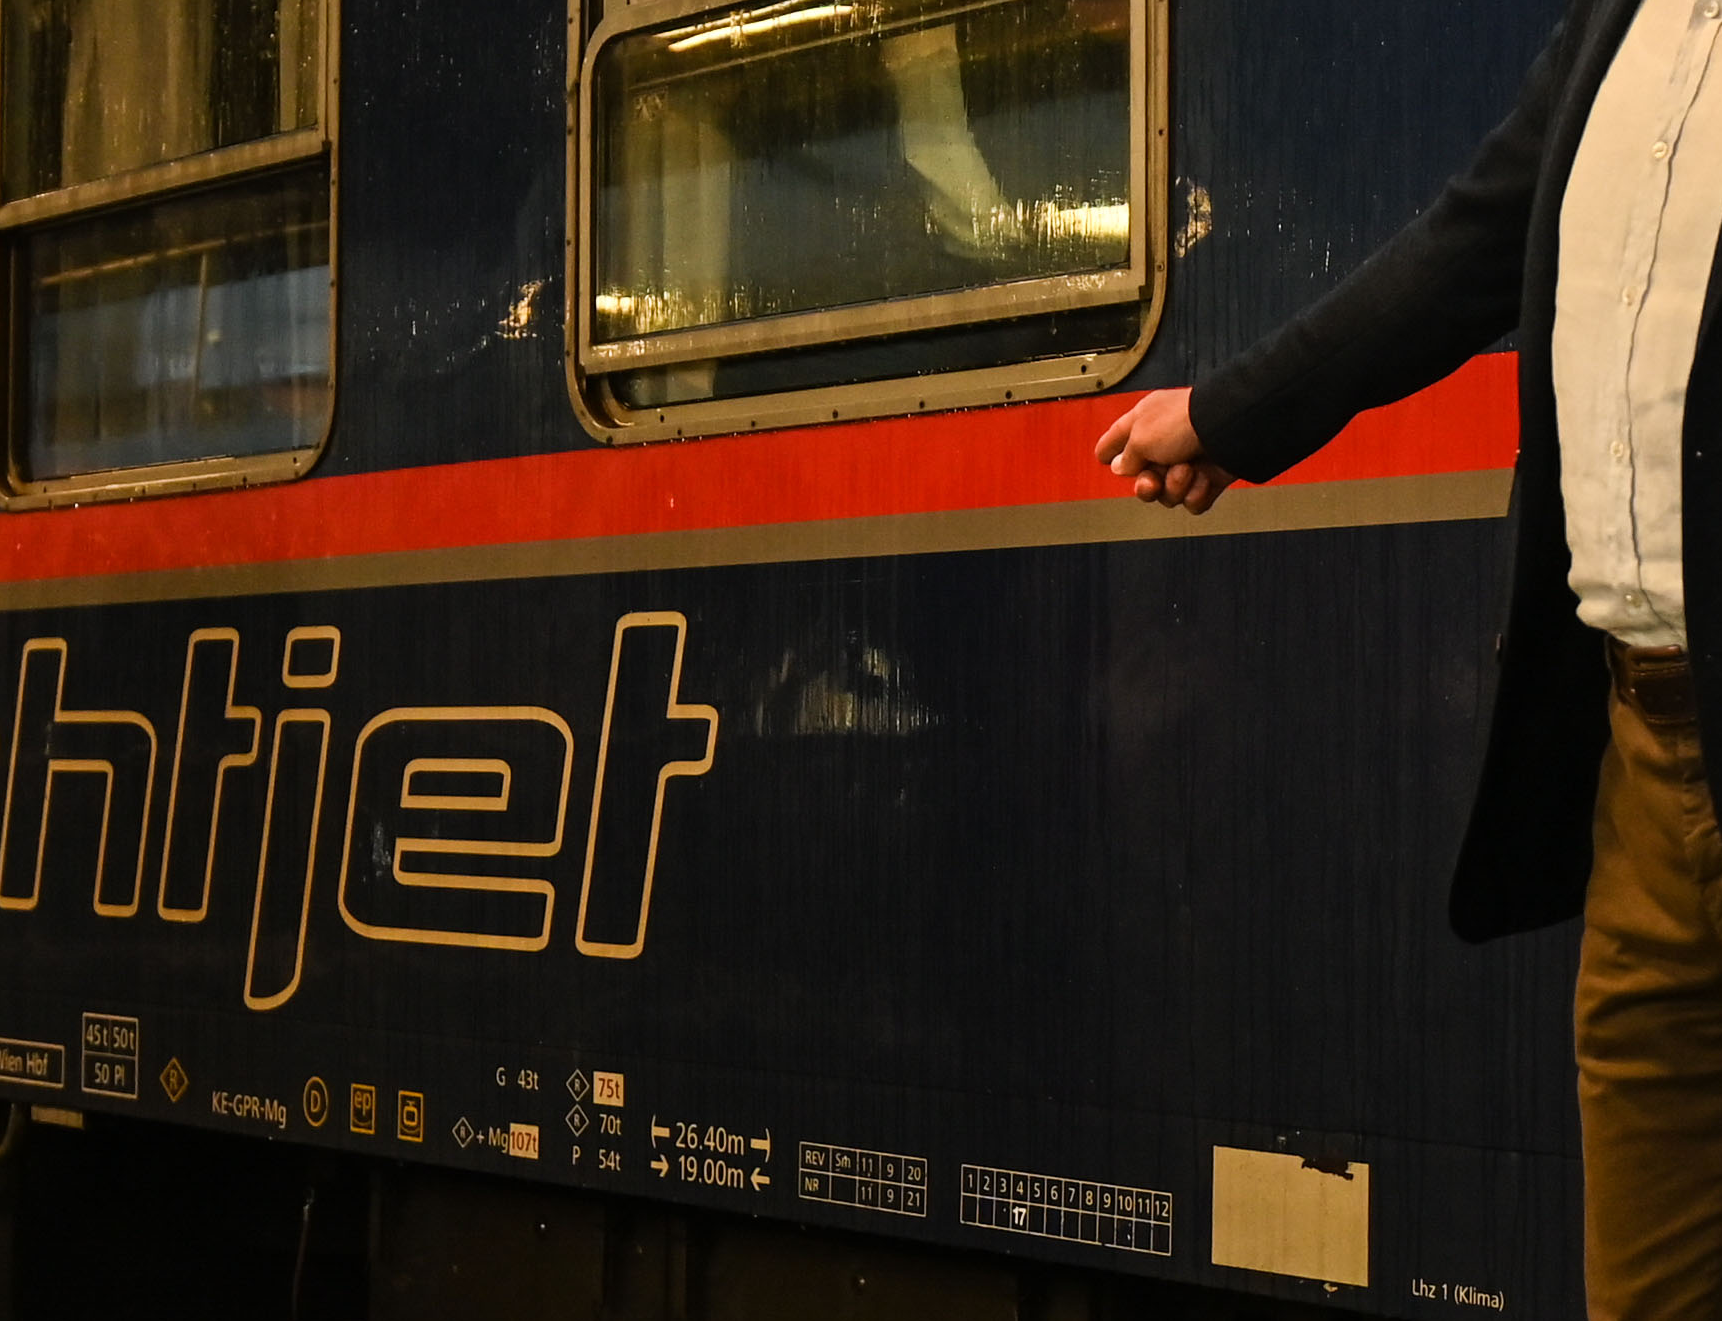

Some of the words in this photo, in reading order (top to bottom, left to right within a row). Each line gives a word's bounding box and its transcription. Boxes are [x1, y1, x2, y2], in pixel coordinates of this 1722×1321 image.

[26, 1050, 48, 1077] Hbf
[94, 1061, 110, 1084] 50
[495, 1066, 506, 1087] G
[517, 1069, 540, 1090] 43t
[598, 1077, 621, 1100] 75t
[211, 1090, 288, 1129] KE-GPR-Mg
[310, 1089, 321, 1113] D
[354, 1090, 372, 1117] ep
[599, 1113, 622, 1136] 70t
[488, 1126, 509, 1154] Mg
[510, 1130, 539, 1154] 107t
[676, 1122, 745, 1156] 26.40m
[572, 1144, 582, 1166] P
[599, 1148, 622, 1172] 54t
[805, 1149, 826, 1167] REV
[861, 1157, 874, 1174] 11
[886, 1162, 895, 1179] 9
[907, 1165, 923, 1182] 20
[678, 1157, 744, 1191] 19.00m
[804, 1176, 820, 1192] NR
[861, 1185, 873, 1201] 11
[886, 1188, 895, 1204] 9
[907, 1190, 921, 1207] 21
[967, 1172, 974, 1188] 1
[982, 1175, 991, 1192] 2
[999, 1177, 1008, 1194] 3
[1015, 1180, 1024, 1196] 4
[1033, 1182, 1041, 1198] 5
[1050, 1185, 1059, 1201] 6
[1067, 1187, 1077, 1203] 7
[1085, 1190, 1094, 1206] 8
[1102, 1192, 1112, 1209] 9
[1118, 1194, 1134, 1212] 10
[1137, 1197, 1150, 1214] 11
[1154, 1200, 1170, 1218] 12
[1012, 1206, 1027, 1227] 17
[1412, 1279, 1437, 1300] Lhz
[1441, 1283, 1449, 1300] 1
[1454, 1285, 1505, 1311] (Klima)
